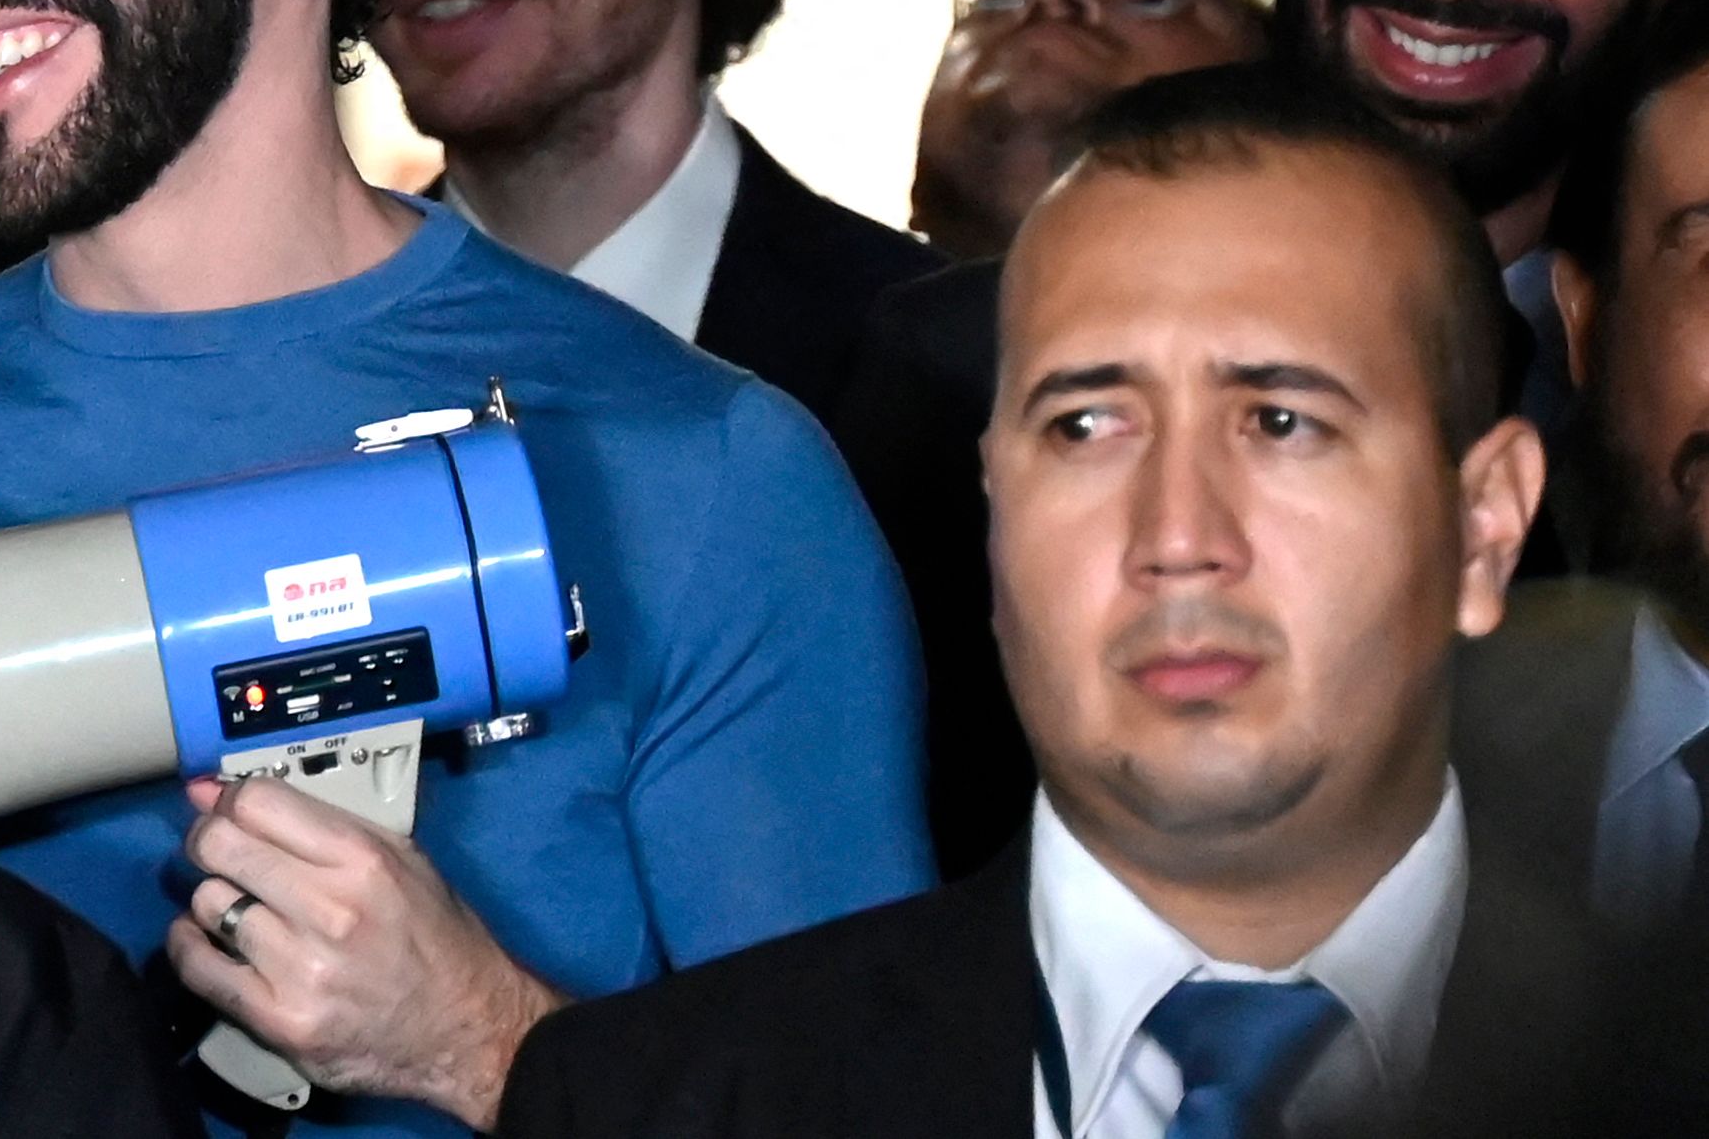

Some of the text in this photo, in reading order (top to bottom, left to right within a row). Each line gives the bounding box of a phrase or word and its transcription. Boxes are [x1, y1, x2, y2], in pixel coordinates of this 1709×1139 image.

[297, 710, 320, 723] USB
[287, 736, 347, 756] ON OFF
